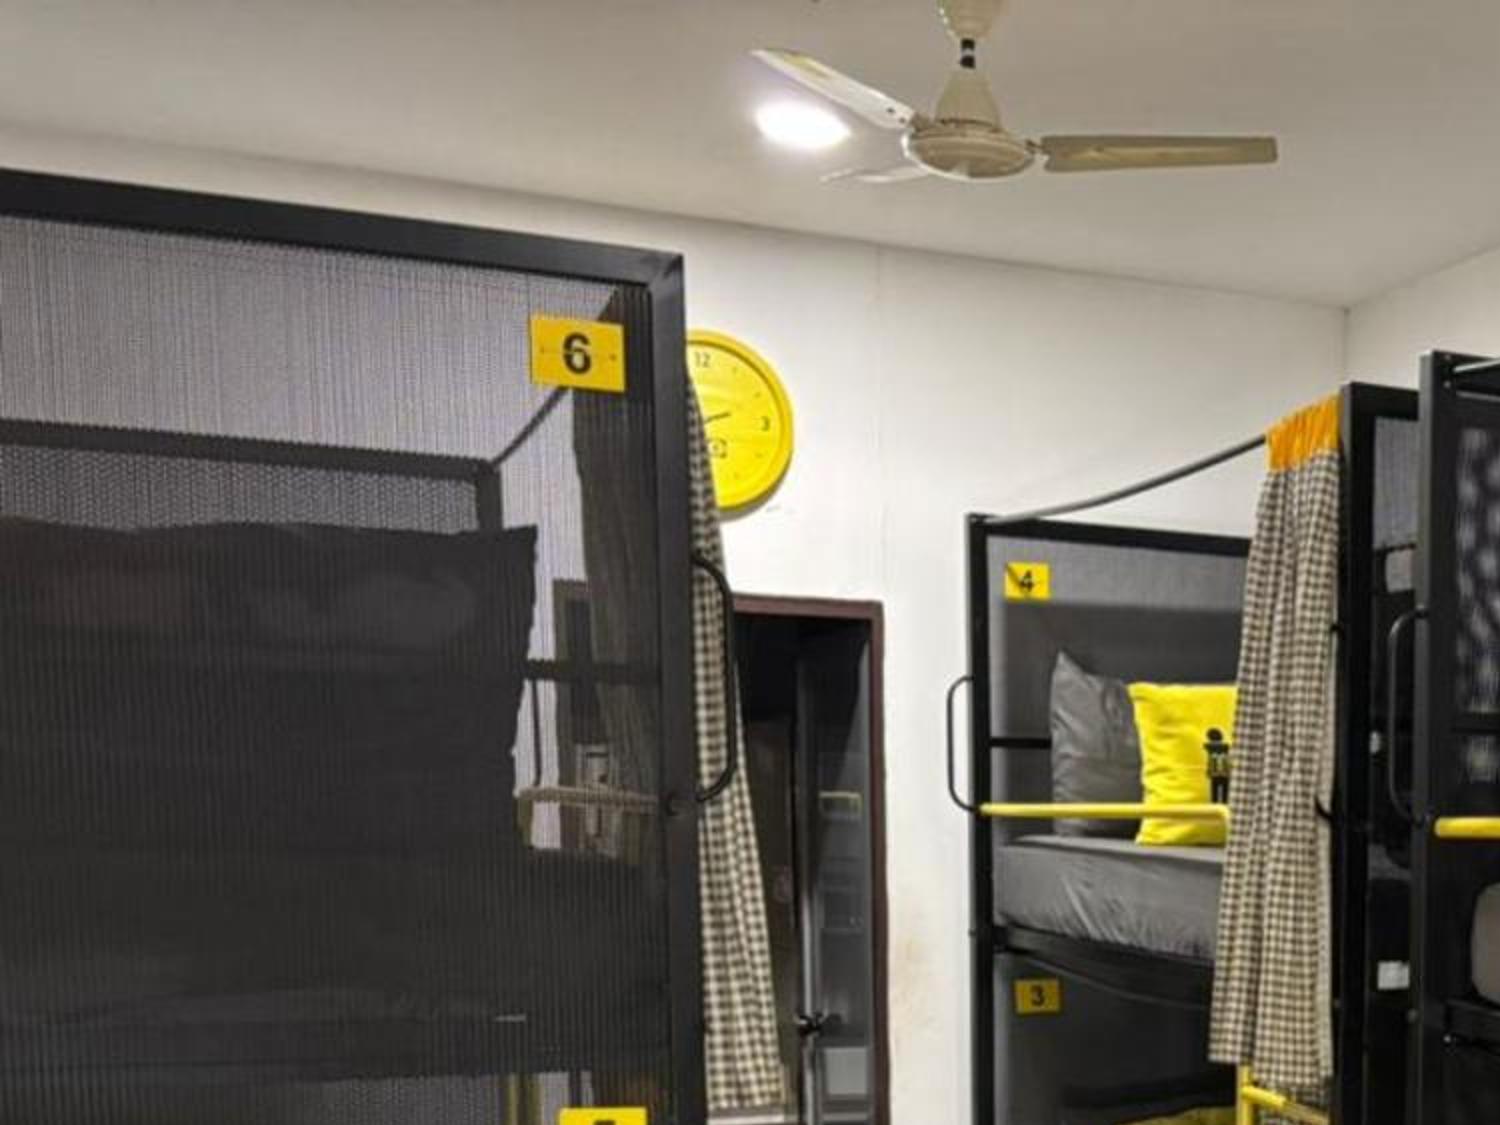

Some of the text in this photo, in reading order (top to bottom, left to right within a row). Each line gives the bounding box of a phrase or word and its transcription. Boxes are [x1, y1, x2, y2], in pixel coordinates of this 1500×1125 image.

[562, 332, 592, 375] 6
[695, 352, 711, 368] 12
[1018, 569, 1035, 594] 4
[1031, 985, 1046, 1007] 3
